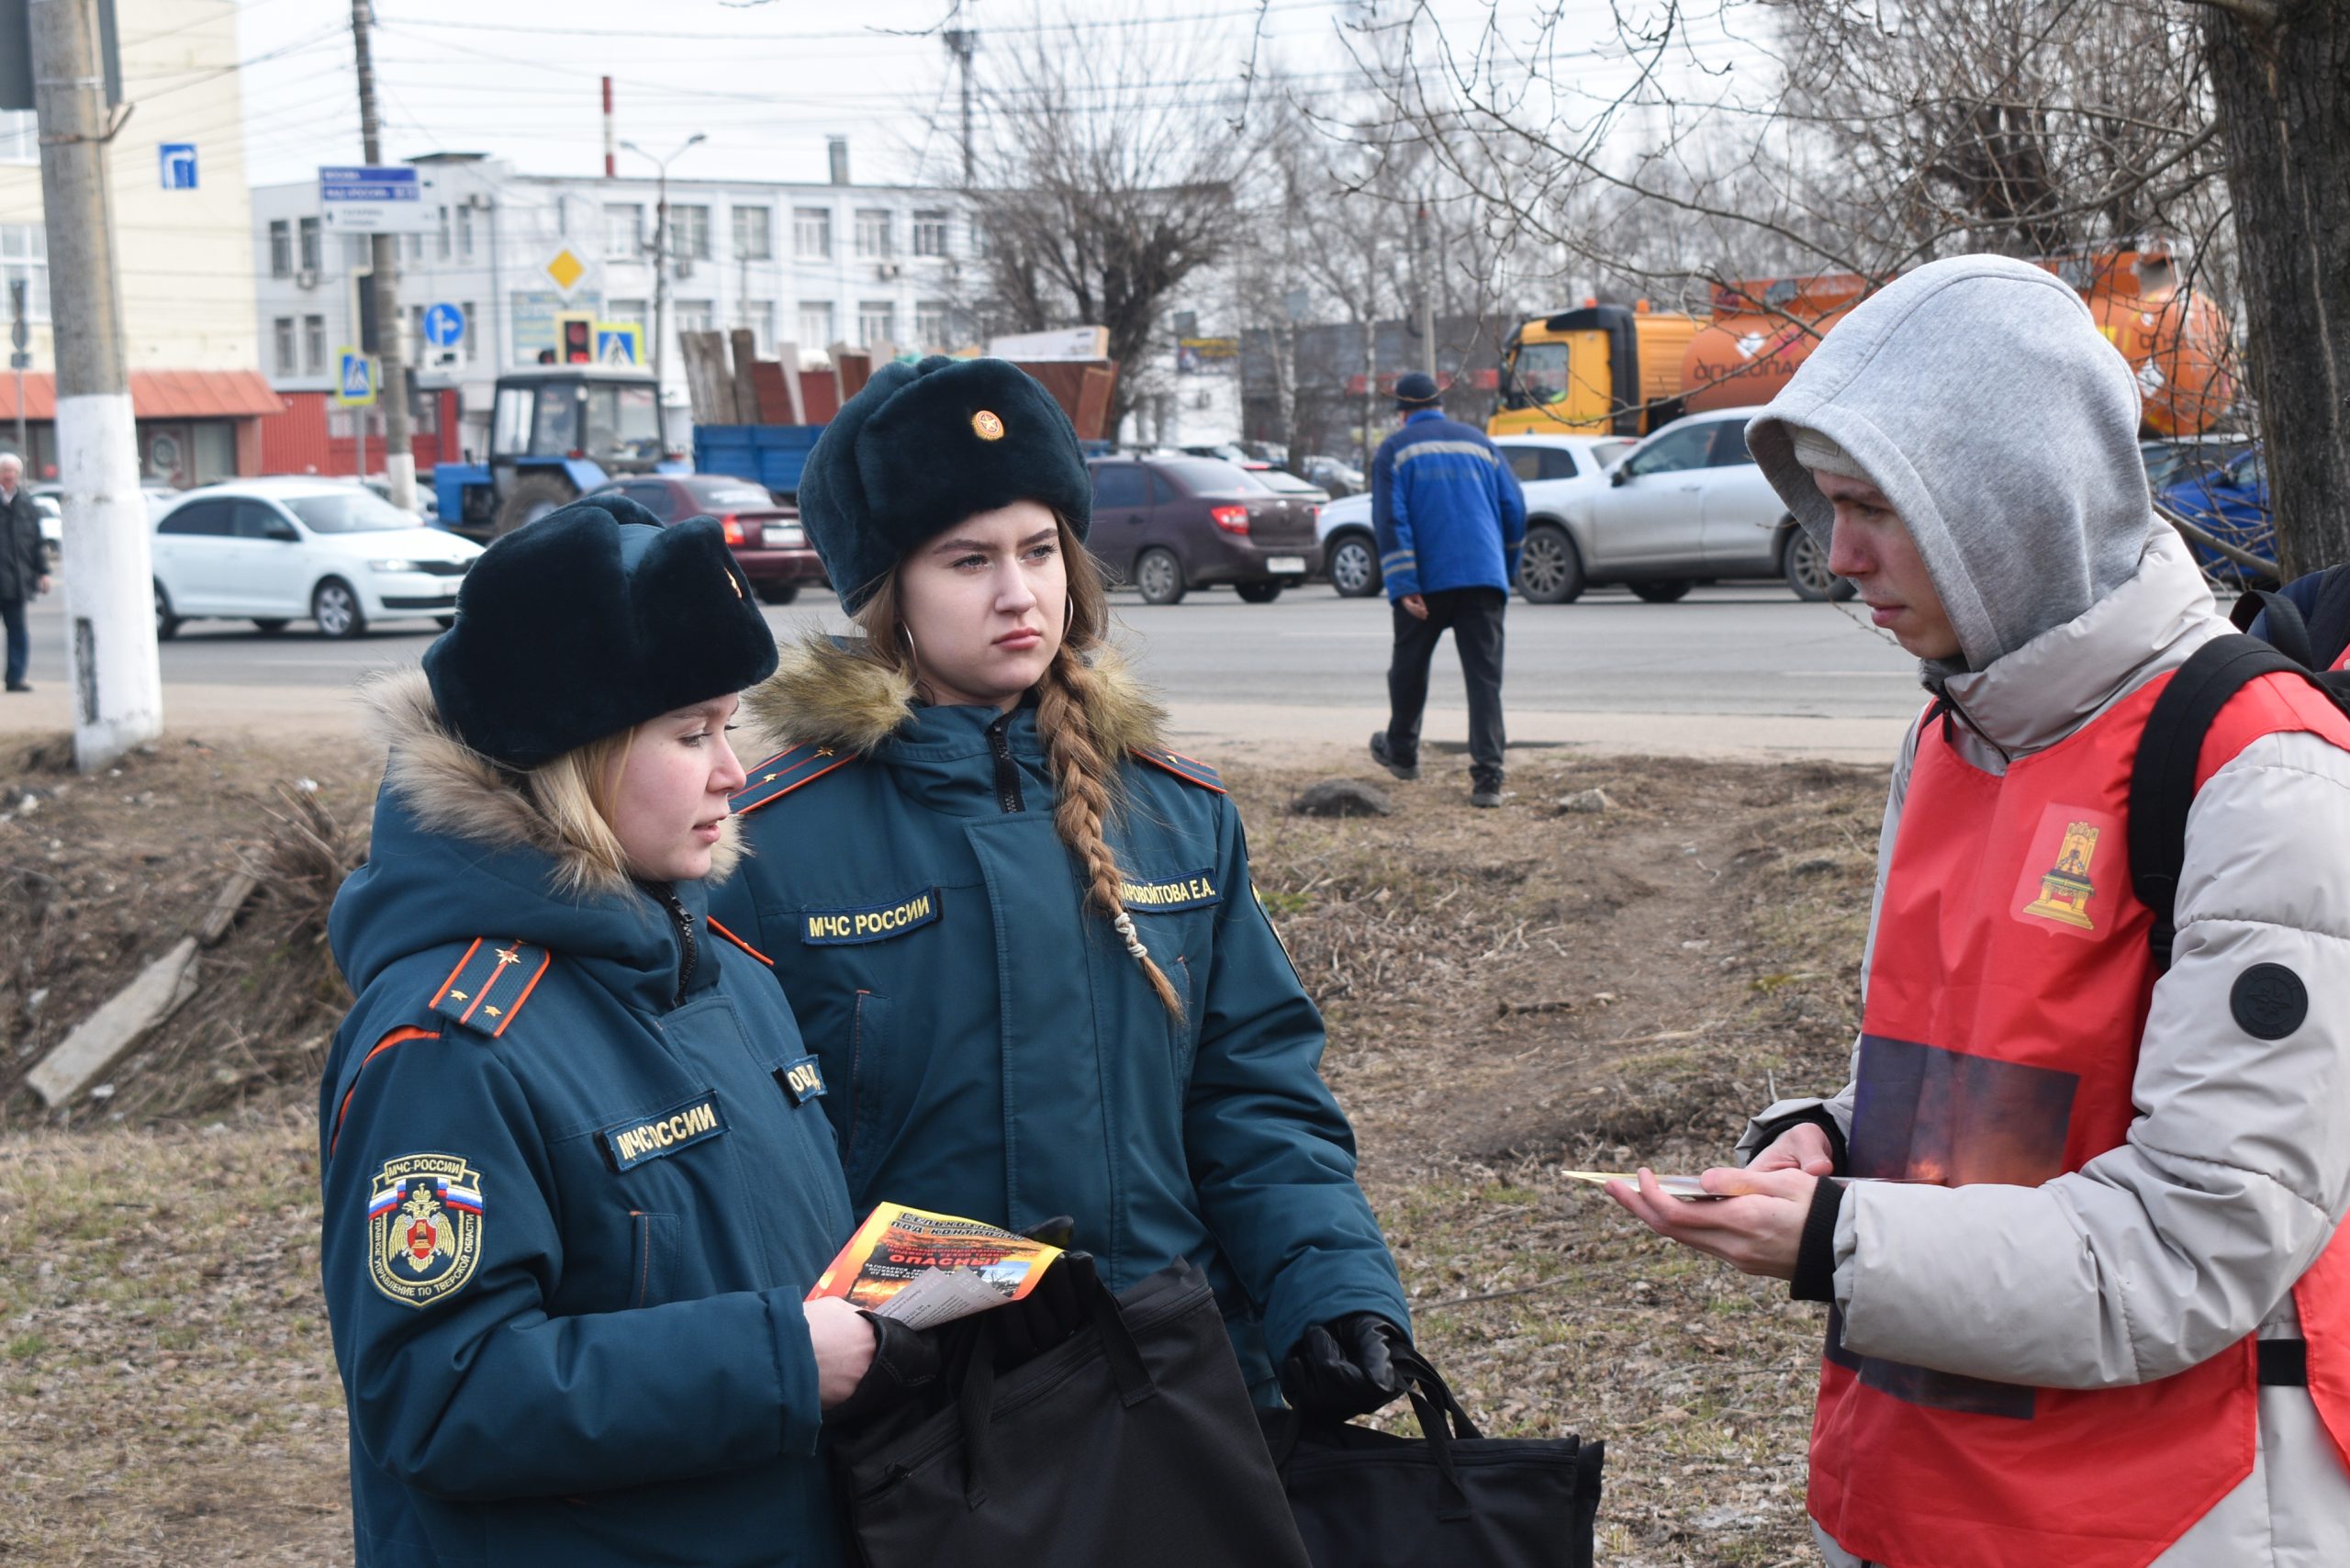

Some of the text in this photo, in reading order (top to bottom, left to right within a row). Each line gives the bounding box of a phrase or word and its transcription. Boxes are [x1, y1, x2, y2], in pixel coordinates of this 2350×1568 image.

[809, 895, 930, 937] МЧС РОССИИ
[387, 1159, 460, 1176] МЧС РОССИИ
[890, 1220, 924, 1235] ПОД
[373, 1214, 475, 1296] ГЛАВНОЕ УПРАВЛЕНИЕ ПО ТВЕРСКОЙ ОБЛАСТИ
[889, 1254, 1001, 1267] ОПАСНЫ!
